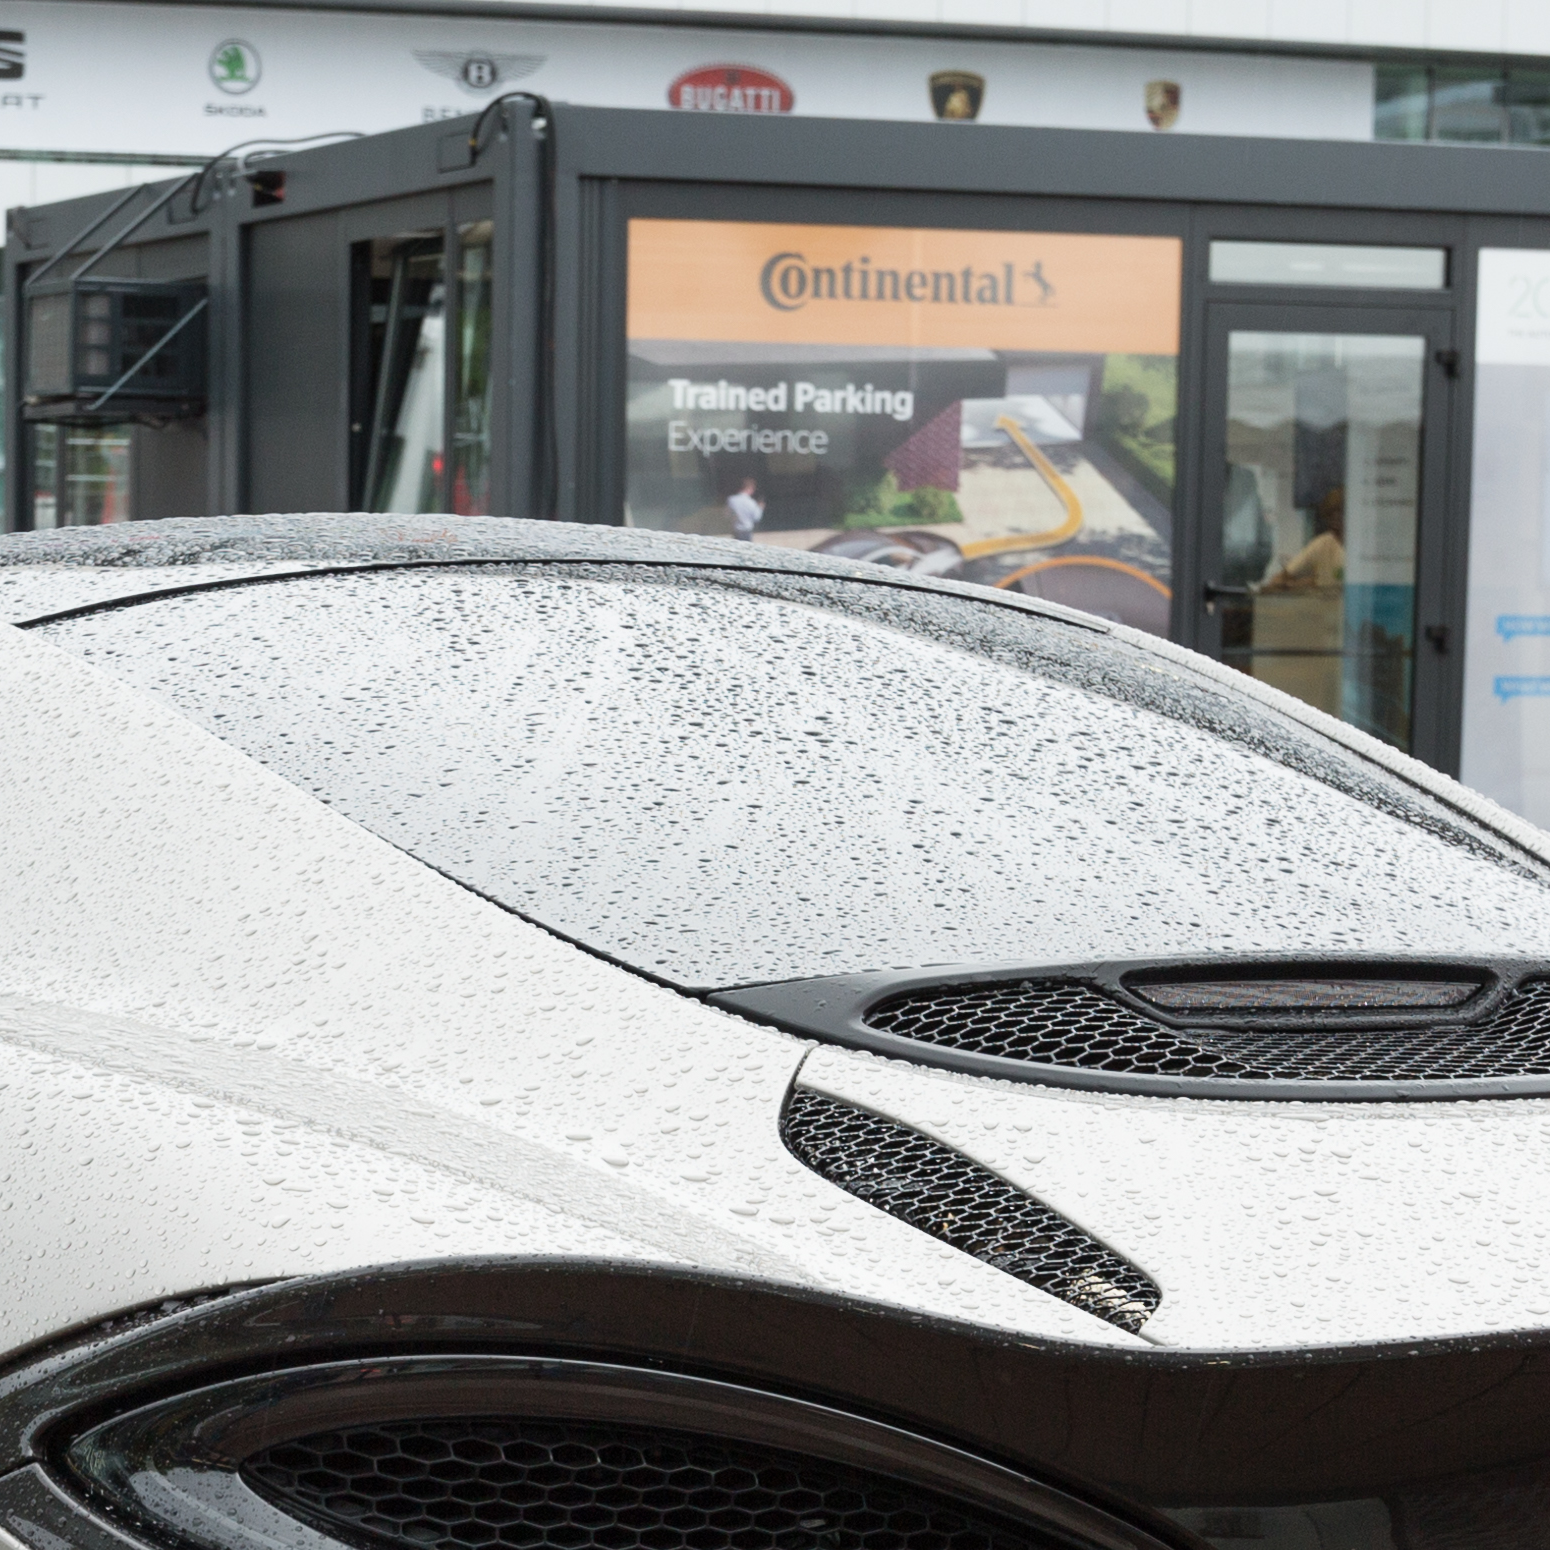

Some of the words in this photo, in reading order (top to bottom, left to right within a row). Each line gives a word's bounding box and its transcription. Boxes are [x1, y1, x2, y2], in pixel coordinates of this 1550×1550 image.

[680, 85, 781, 113] BUGATTI
[759, 251, 1014, 312] Continental
[667, 378, 788, 411] Trained
[794, 381, 915, 421] Parking
[667, 420, 830, 457] Experience
